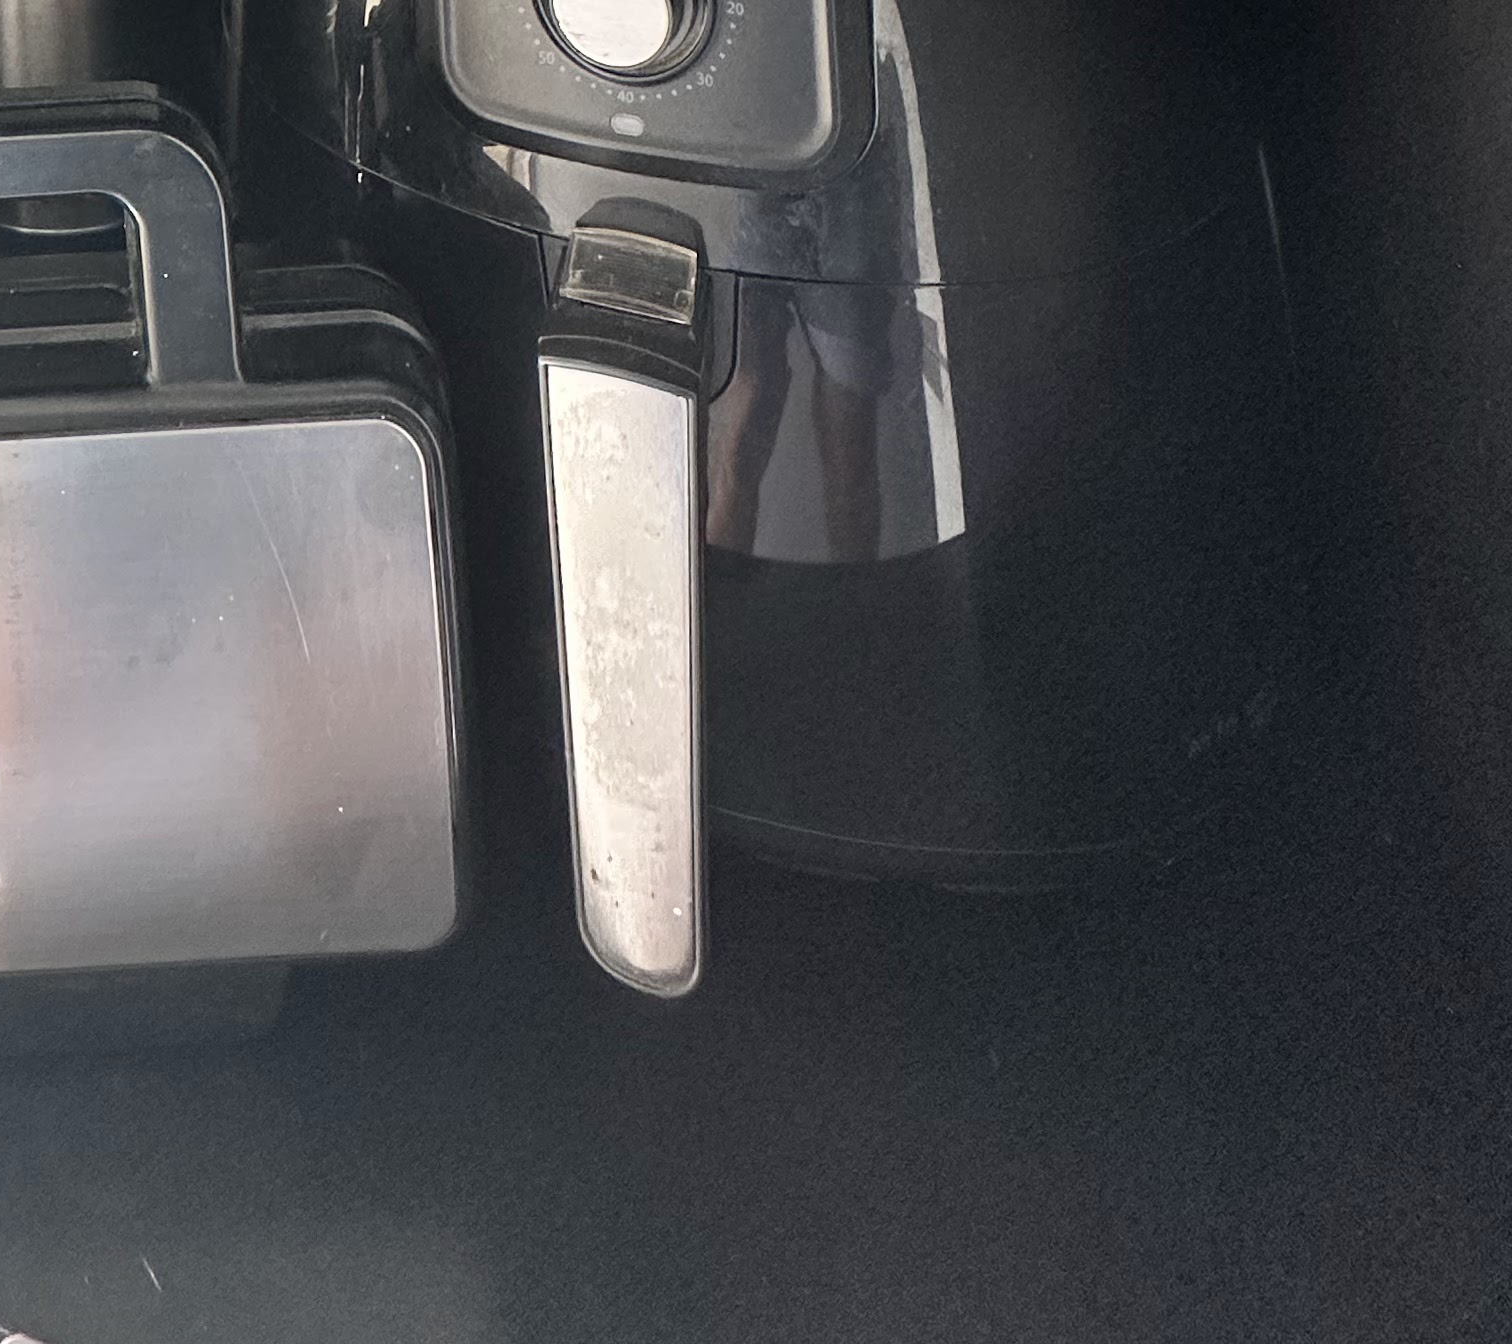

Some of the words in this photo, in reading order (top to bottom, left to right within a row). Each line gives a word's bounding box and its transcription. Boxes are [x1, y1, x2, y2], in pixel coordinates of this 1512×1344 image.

[726, 2, 744, 16] 20
[538, 52, 554, 64] 50
[697, 72, 713, 87] 30
[617, 90, 634, 103] 40
